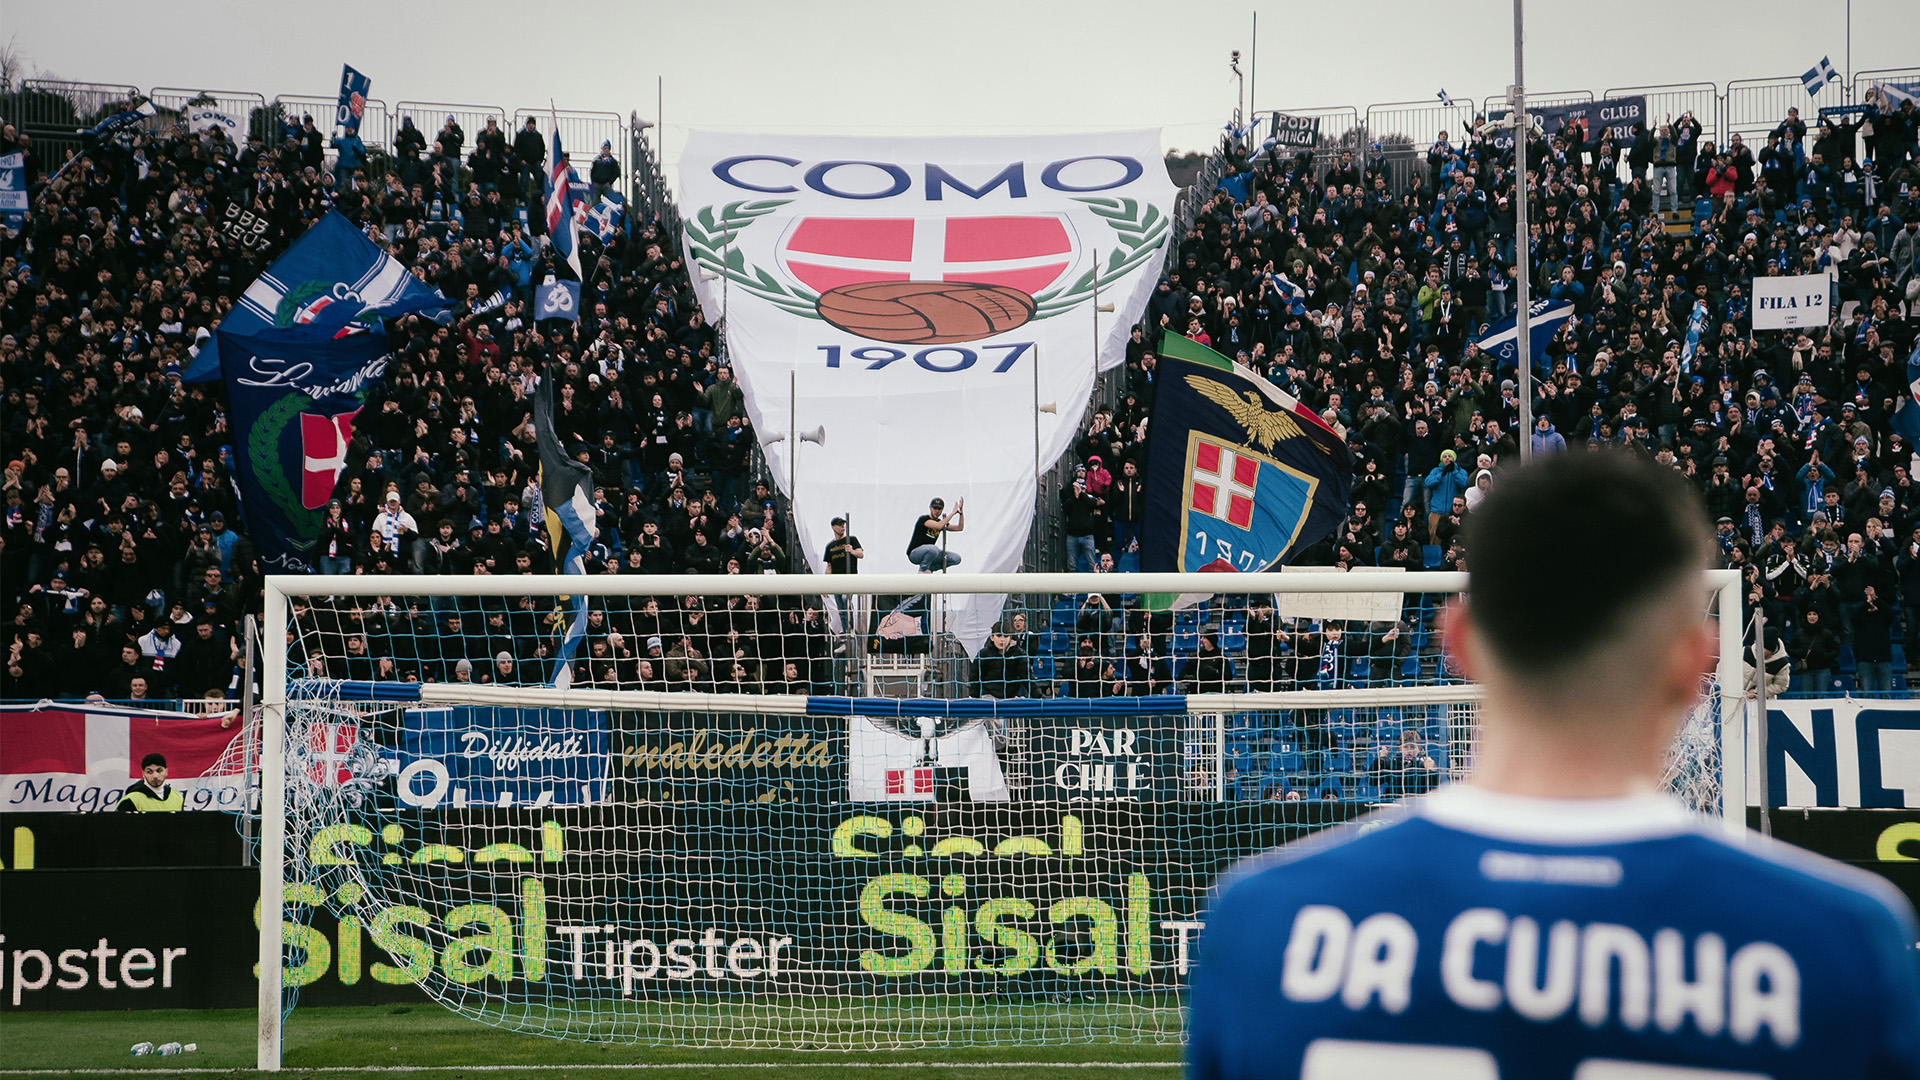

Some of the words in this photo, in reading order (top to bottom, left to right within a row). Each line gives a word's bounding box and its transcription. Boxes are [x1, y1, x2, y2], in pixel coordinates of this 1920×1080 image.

[192, 111, 237, 129] COMO
[1278, 115, 1315, 130] PODI
[1600, 105, 1640, 121] CLUB
[1276, 129, 1313, 145] MINGA
[711, 155, 1144, 201] COMO
[225, 202, 270, 235] BBB
[1759, 296, 1798, 310] FILA
[1805, 293, 1823, 308] 12
[817, 341, 1035, 374] 1907
[461, 731, 584, 771] Diffidati
[624, 727, 834, 770] maledetta
[1070, 729, 1136, 757] PAR
[180, 784, 260, 811] 190
[253, 877, 546, 986] Sisal
[860, 872, 1151, 976] Sisal
[556, 923, 792, 995] Tipster
[1282, 904, 1418, 1012] DA
[1440, 906, 1800, 1048] CUNHA
